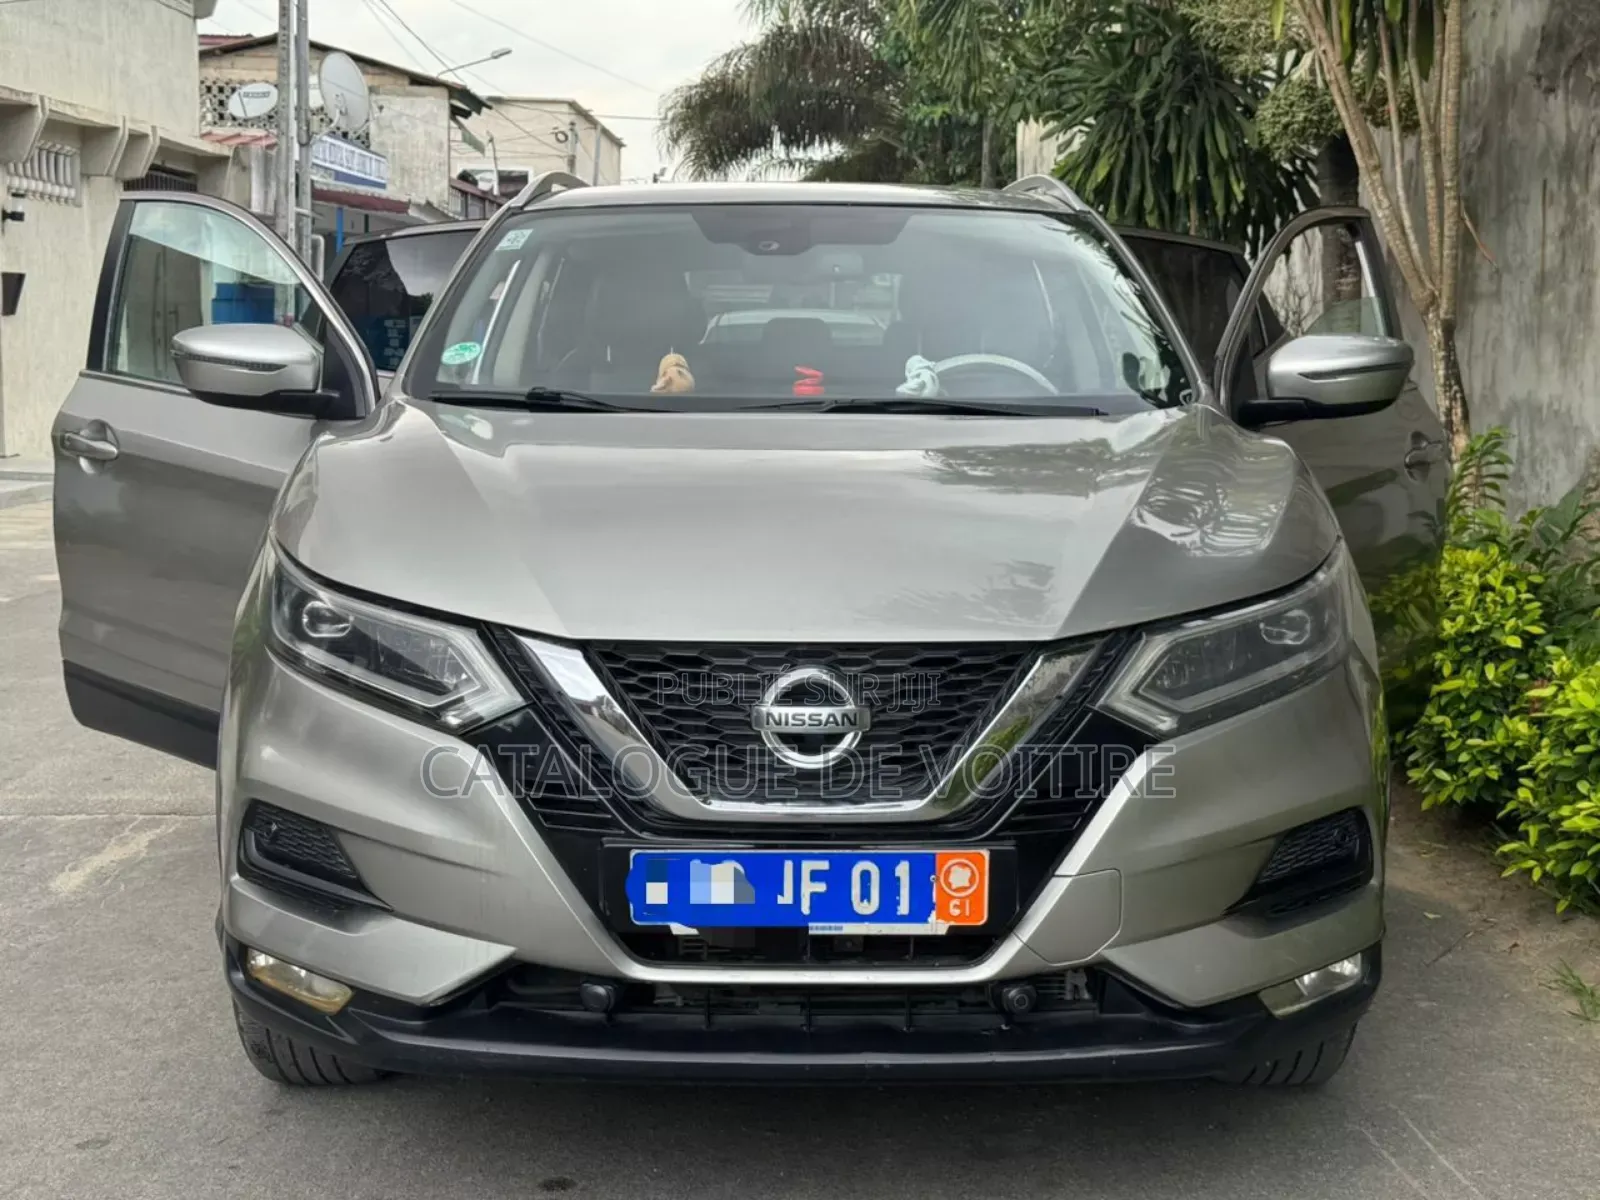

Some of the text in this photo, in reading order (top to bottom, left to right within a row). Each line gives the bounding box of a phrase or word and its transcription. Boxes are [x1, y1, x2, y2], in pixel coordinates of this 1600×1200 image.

[764, 711, 858, 727] NISSAN
[777, 859, 830, 916] JF
[852, 859, 910, 916] 01
